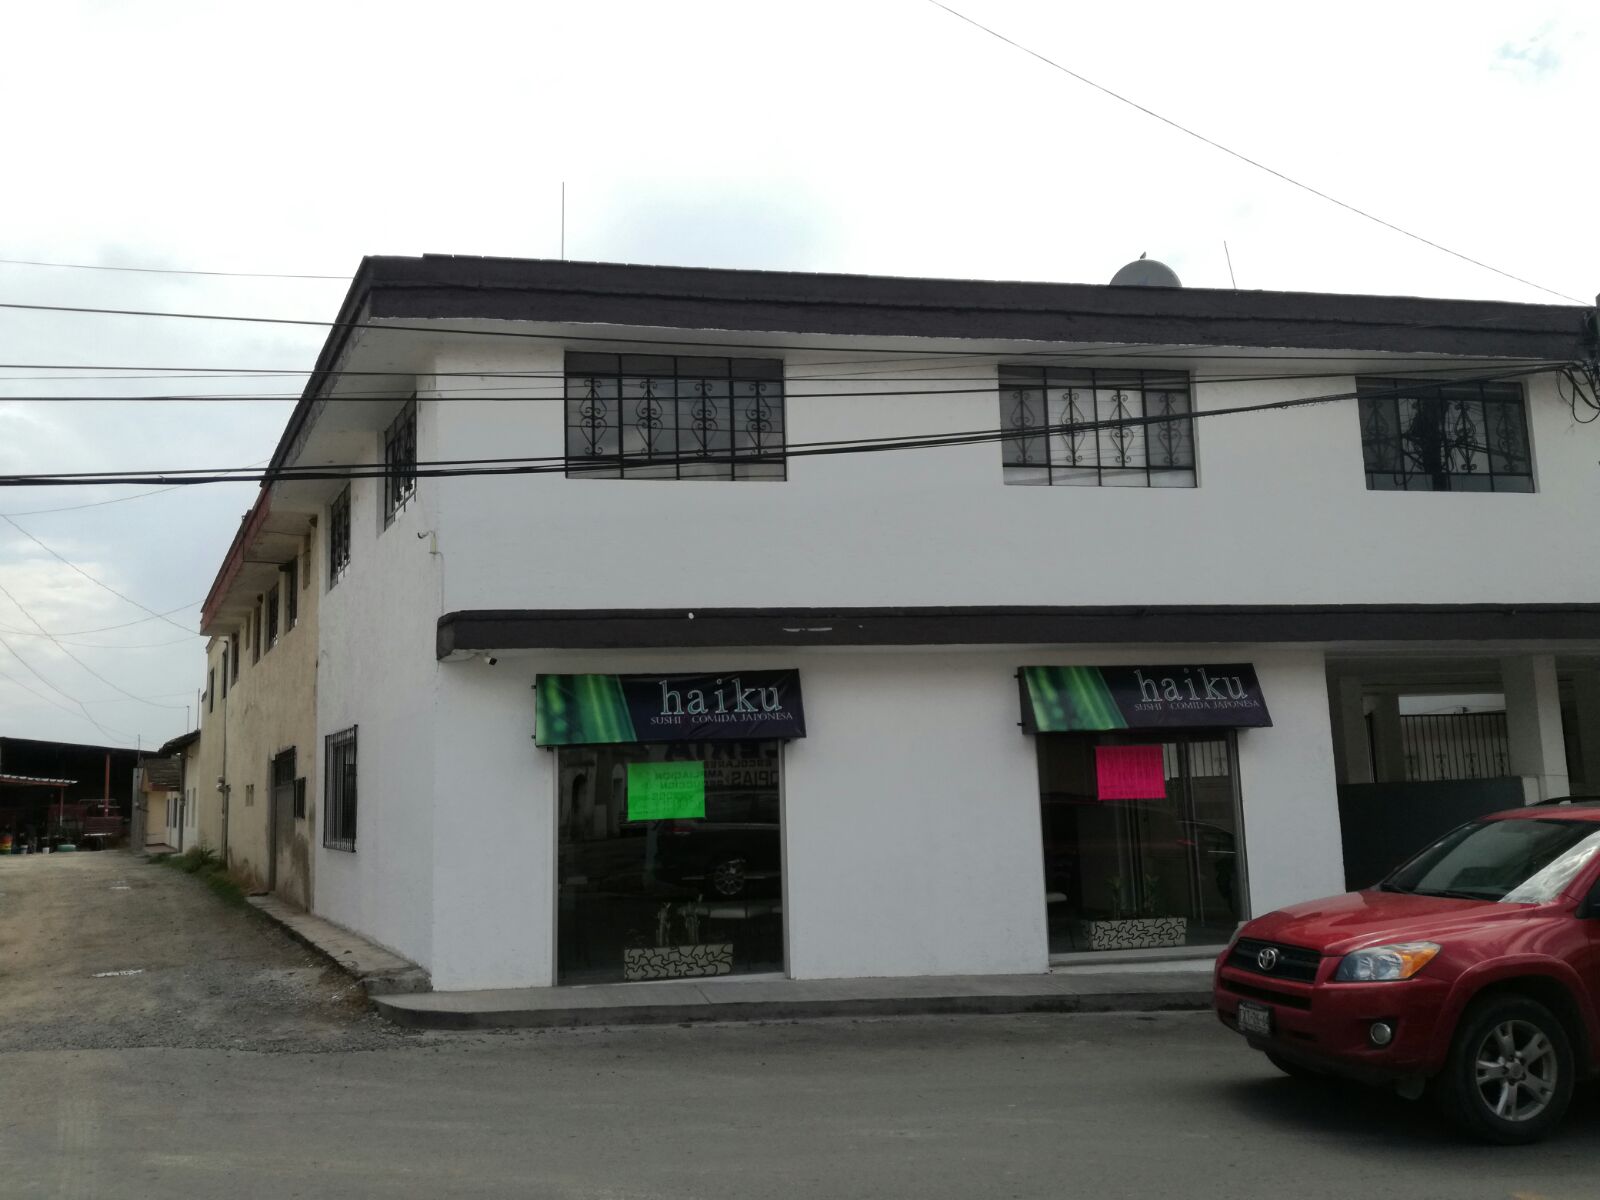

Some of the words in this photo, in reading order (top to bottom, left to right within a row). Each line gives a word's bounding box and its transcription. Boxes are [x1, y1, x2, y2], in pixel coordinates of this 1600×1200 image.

[1133, 667, 1248, 702] haiku
[658, 678, 782, 716] haiku
[1135, 703, 1162, 711] SUSHI
[1170, 701, 1210, 710] COMIDA
[1213, 700, 1260, 709] JAPONESA
[650, 716, 682, 725] SUSHI
[691, 714, 736, 724] COMIDA
[738, 711, 793, 722] JAPONESA
